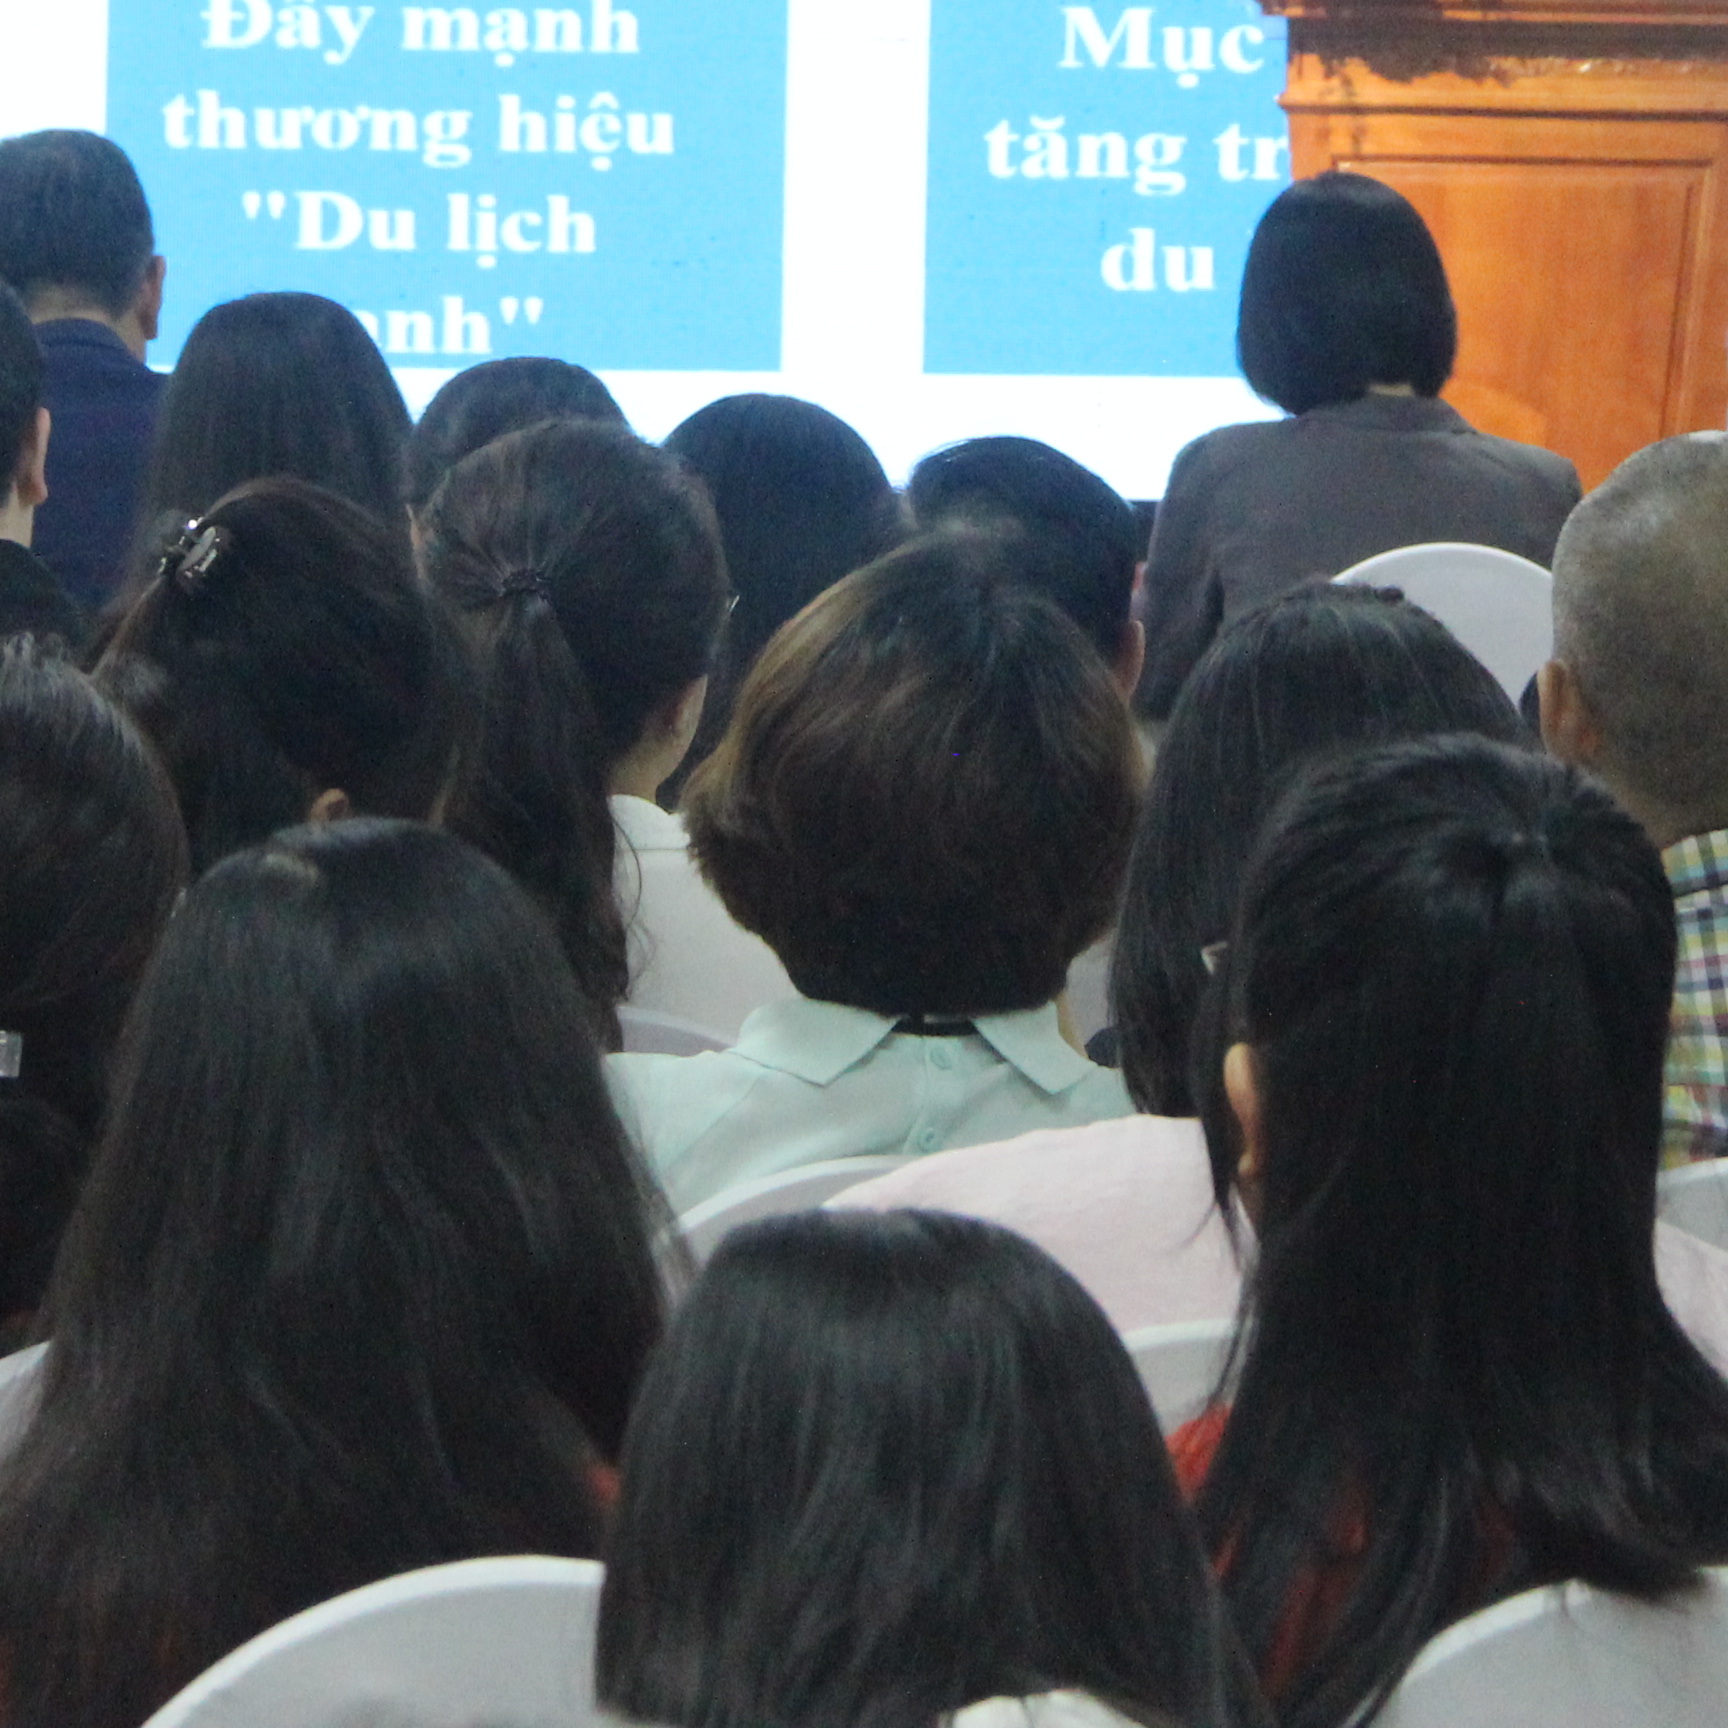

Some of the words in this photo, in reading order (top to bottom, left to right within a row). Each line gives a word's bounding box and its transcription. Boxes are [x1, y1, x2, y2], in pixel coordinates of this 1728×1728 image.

[1059, 5, 1265, 89] Mục
[162, 89, 472, 168] thương
[499, 91, 674, 171] hiệu
[984, 115, 1187, 196] tăng
[242, 190, 416, 251] "Du
[447, 192, 596, 269] lịch
[1101, 227, 1215, 293] du
